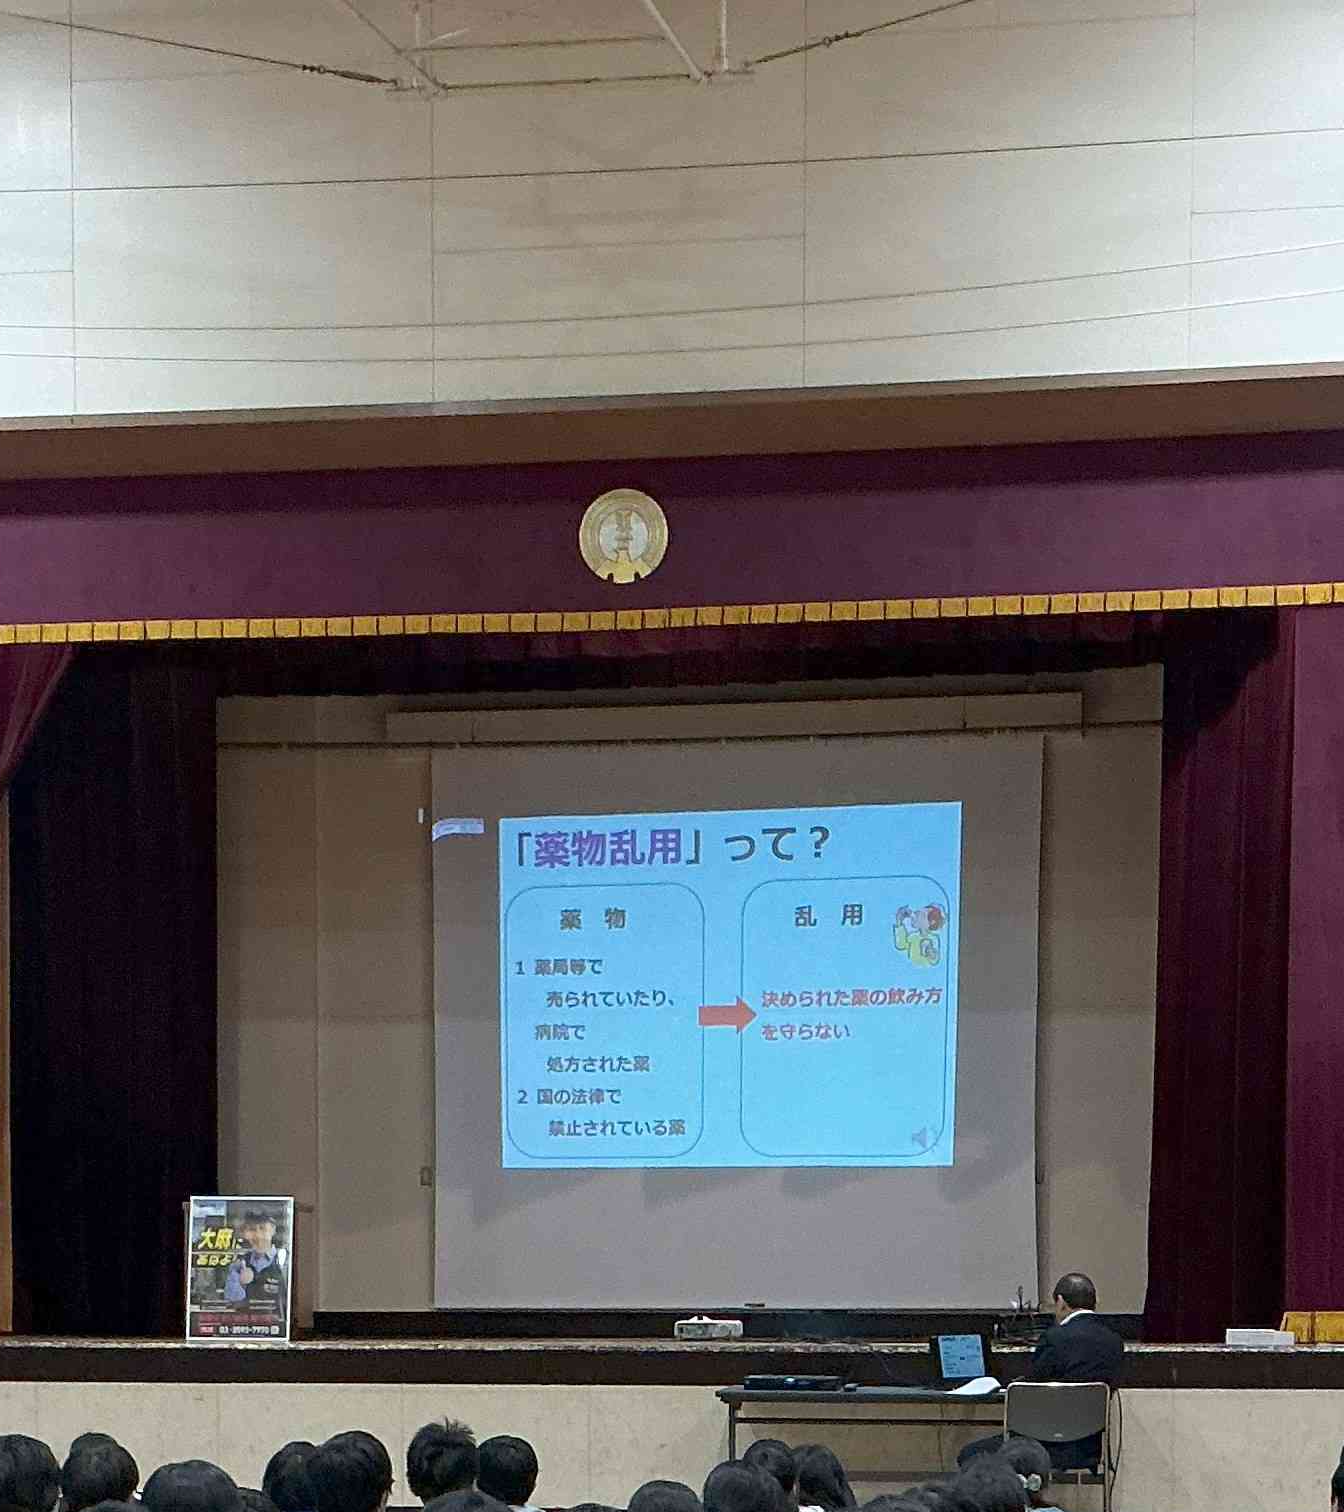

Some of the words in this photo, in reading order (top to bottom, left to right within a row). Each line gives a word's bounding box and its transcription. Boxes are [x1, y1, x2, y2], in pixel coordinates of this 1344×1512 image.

[534, 957, 604, 978] 薬局等で
[761, 987, 944, 1008] 決められた薬の飲み方
[534, 1022, 587, 1041] 病院で
[761, 1022, 851, 1041] を守らない
[546, 1055, 651, 1075] 処方された薬
[517, 1089, 528, 1105] 2
[536, 1086, 622, 1107] 国の法律で
[548, 1119, 687, 1139] 禁止されている薬
